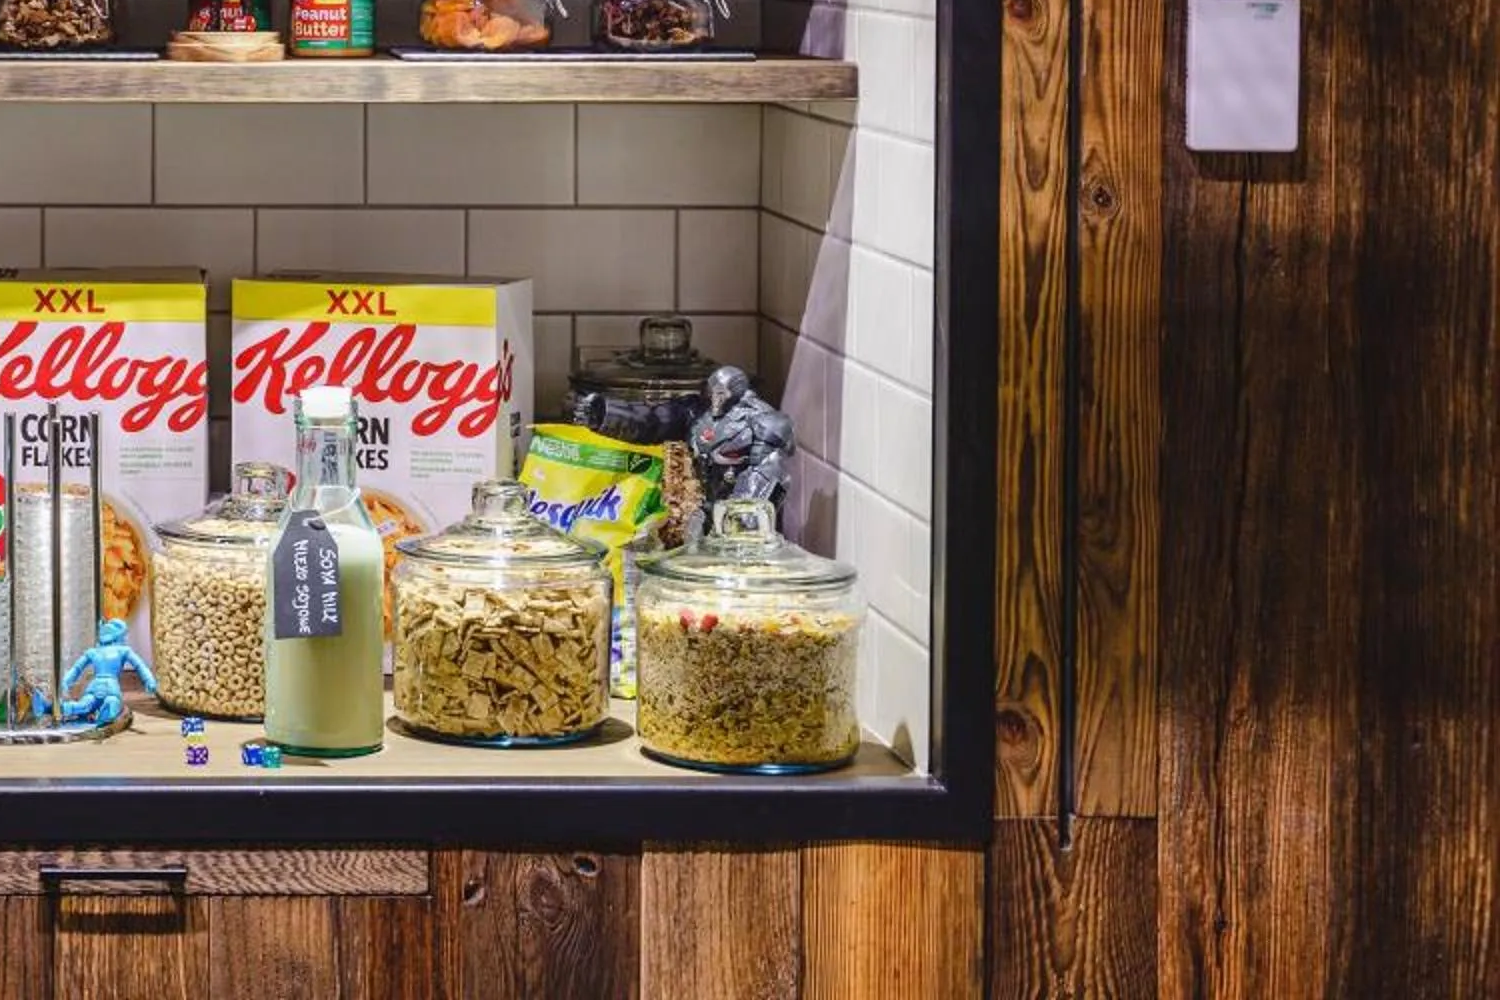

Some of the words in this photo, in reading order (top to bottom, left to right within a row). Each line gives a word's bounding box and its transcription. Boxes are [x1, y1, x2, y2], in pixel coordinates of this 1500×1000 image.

[294, 6, 347, 20] Peanut
[294, 21, 347, 36] Butter
[34, 288, 105, 313] XXL
[326, 288, 396, 316] XXL
